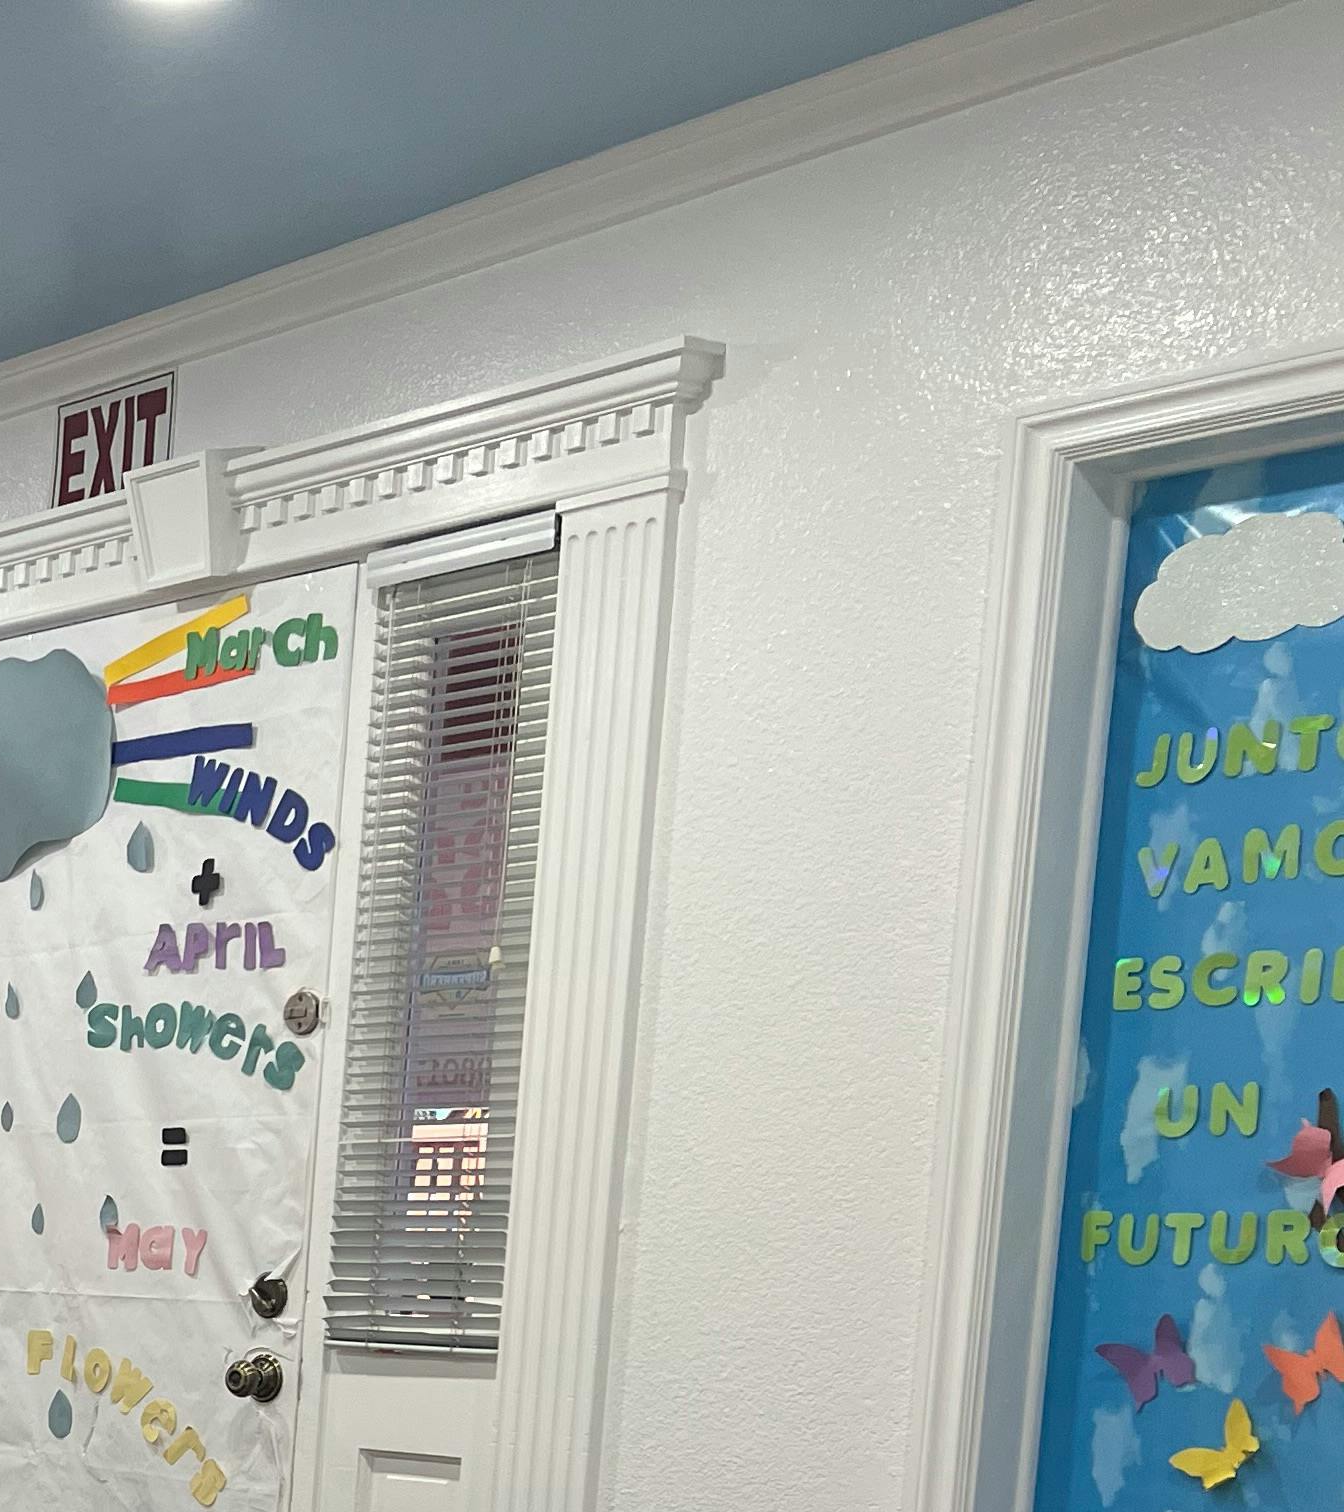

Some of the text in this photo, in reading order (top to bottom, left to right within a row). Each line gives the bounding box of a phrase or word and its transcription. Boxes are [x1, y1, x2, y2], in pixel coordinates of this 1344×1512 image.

[58, 387, 168, 506] EXIT
[1135, 714, 1344, 789] JUNT
[187, 755, 336, 871] WINDS
[1153, 1080, 1261, 1138] UN
